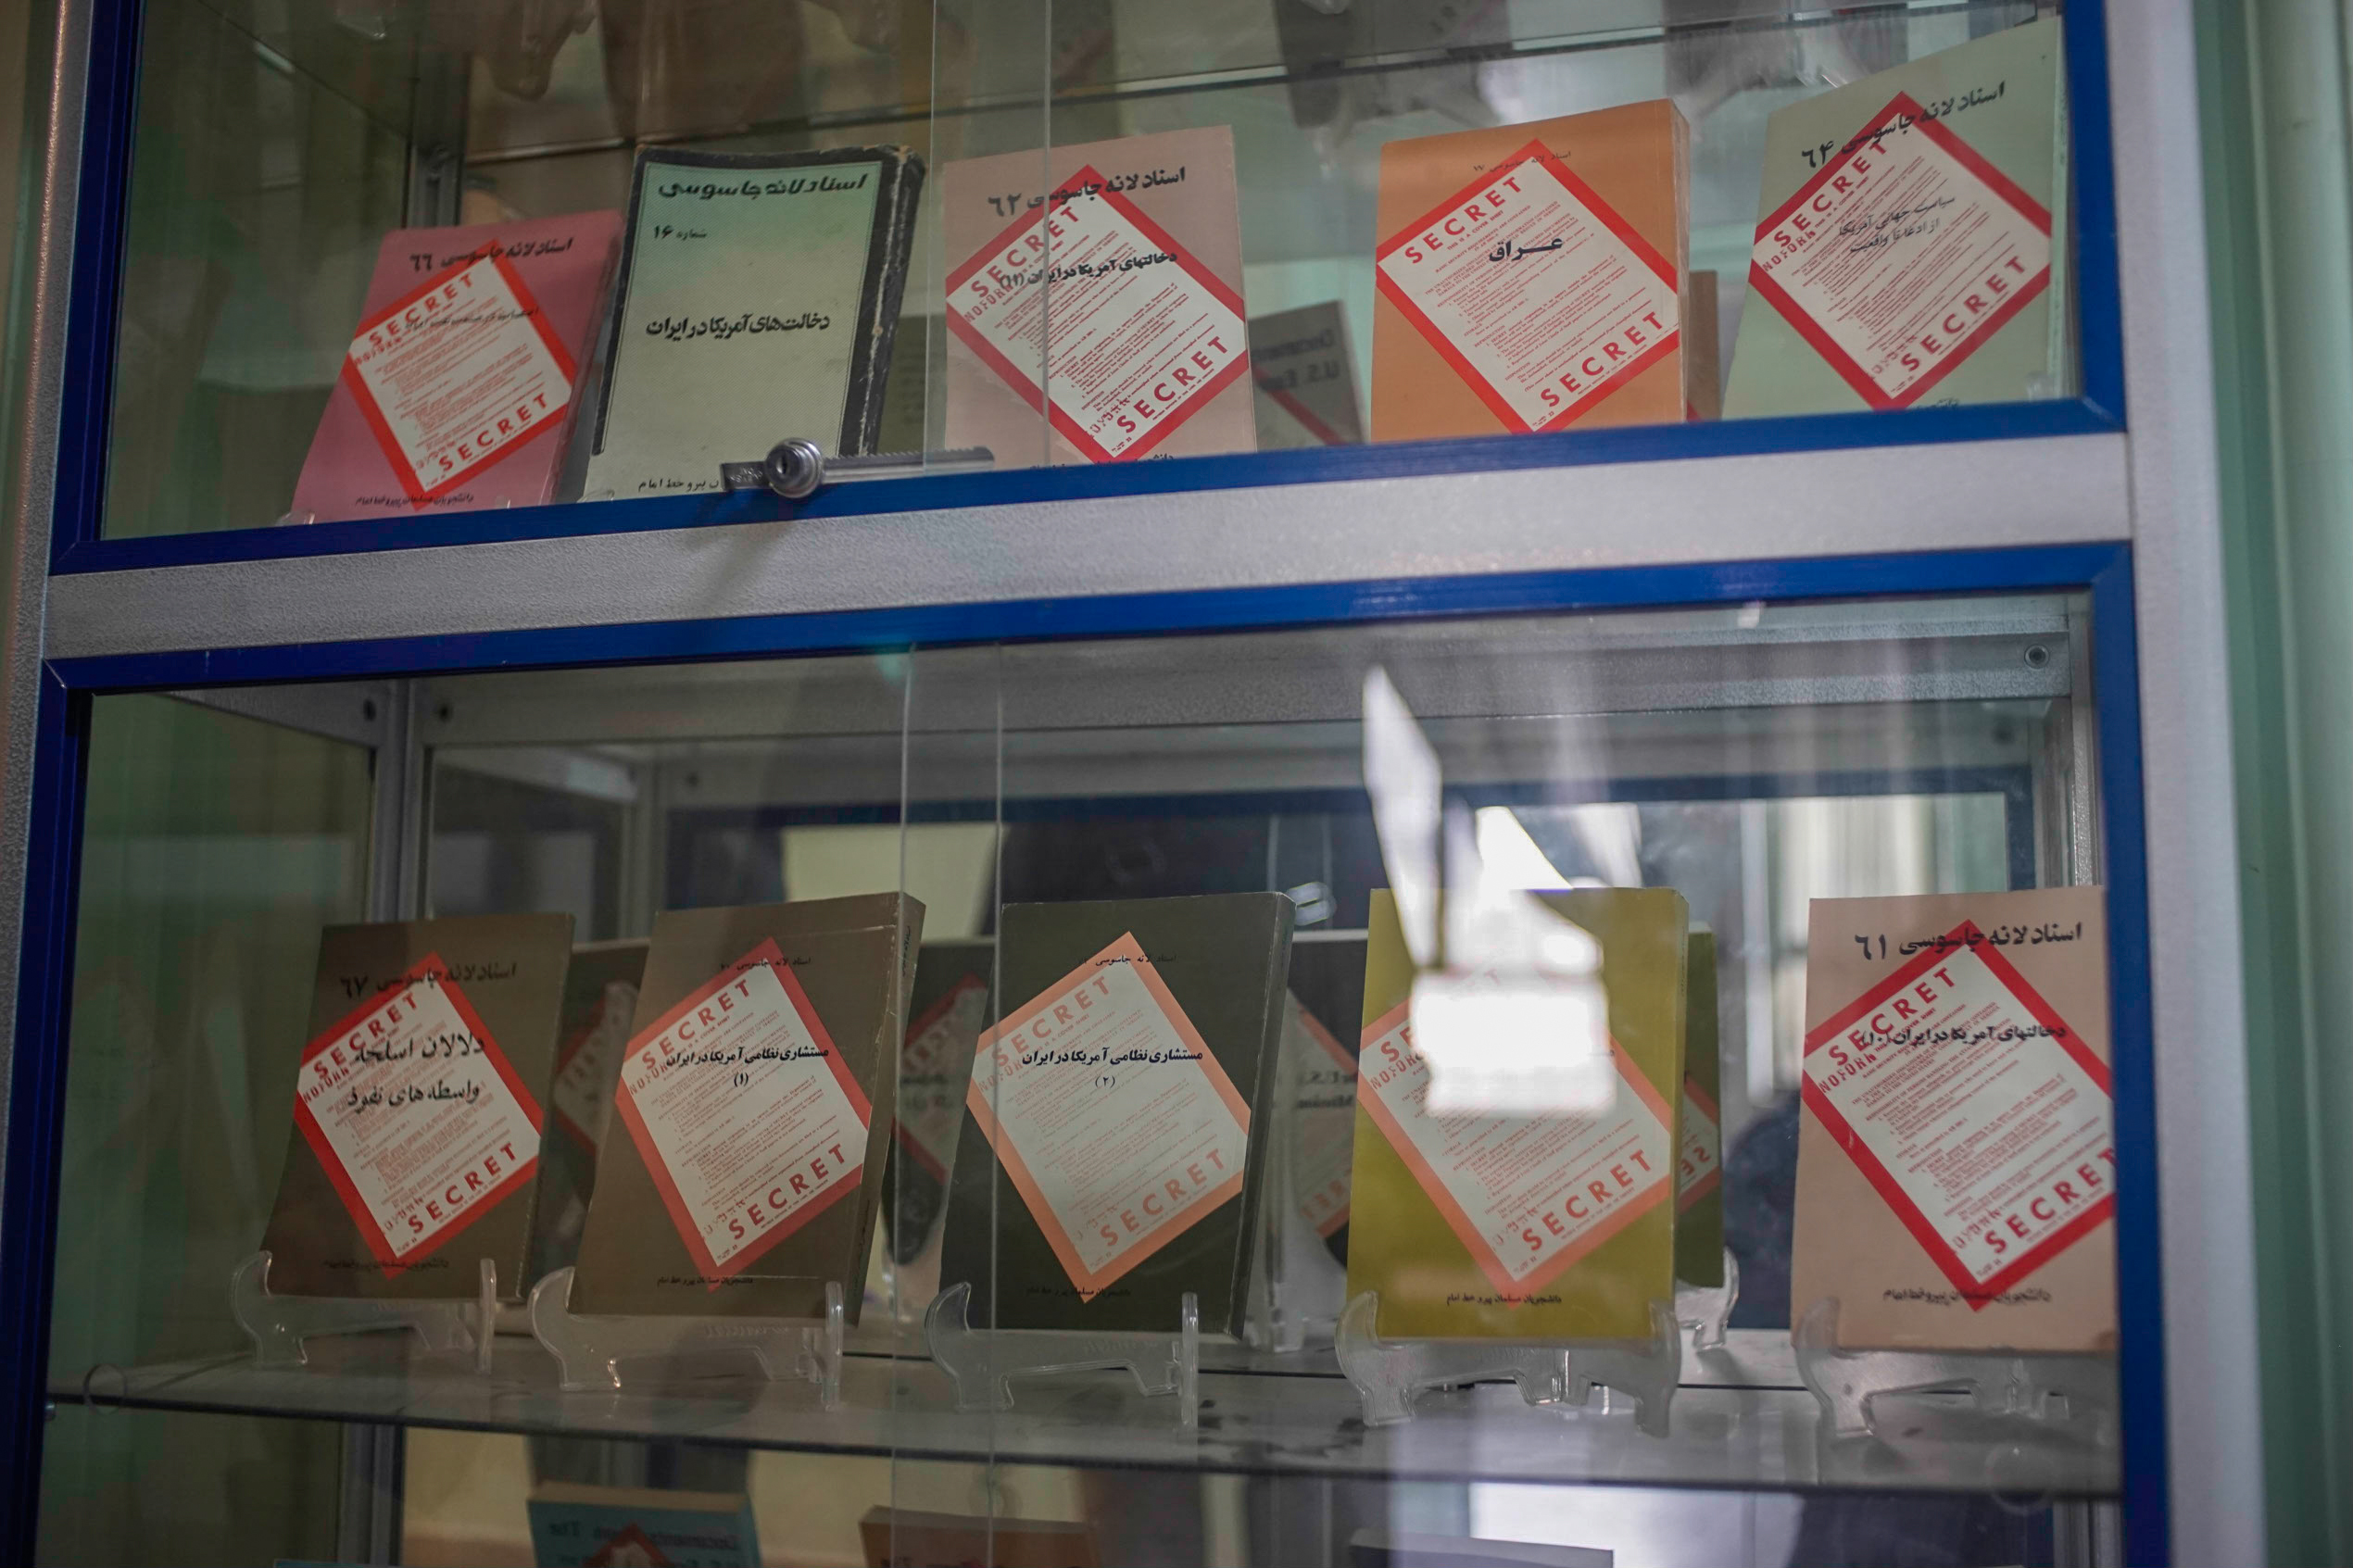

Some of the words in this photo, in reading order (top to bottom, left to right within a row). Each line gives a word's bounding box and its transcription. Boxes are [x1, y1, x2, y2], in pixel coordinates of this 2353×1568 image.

[1957, 81, 2005, 111] اسناد
[1919, 98, 1954, 123] لانه
[1841, 112, 1916, 154] جاسوسی
[766, 179, 807, 195] لانه
[804, 173, 867, 193] اسناد
[1106, 173, 1139, 193] لانه
[1141, 166, 1186, 188] اسناد
[659, 181, 761, 200] جاسوسی
[1026, 180, 1102, 208] جاسوسی
[1772, 144, 1887, 247] SECRET
[1405, 177, 1521, 264] SECRET
[1470, 220, 1489, 233] COVER
[971, 207, 1080, 296] SECRET
[1489, 238, 1563, 261] عراق
[1063, 267, 1078, 280] در
[1078, 259, 1117, 278] آمریکا
[370, 273, 473, 348] SECRET
[1901, 257, 2025, 370] SECRET
[646, 317, 689, 342] ایران
[689, 320, 708, 338] در
[710, 314, 753, 339] آمریکا
[1541, 312, 1664, 407] SECRET
[1117, 337, 1228, 433] SECRET
[439, 393, 548, 471] SECRET
[1899, 928, 1985, 955] جاسوسی
[1990, 924, 2028, 946] لانه
[2031, 922, 2082, 945] اسناد
[641, 980, 750, 1070] SECRET
[996, 976, 1111, 1068] SECRET
[1829, 968, 1957, 1066] SECRET
[314, 993, 419, 1079] SECRET
[422, 1033, 484, 1059] دلالان
[1894, 1028, 1931, 1047] ایران
[1950, 1025, 1994, 1045] آمریکا
[666, 1051, 695, 1068] ایران
[695, 1052, 708, 1065] در
[710, 1047, 743, 1065] آمریکا
[744, 1047, 779, 1063] نظامی
[779, 1046, 829, 1061] مستشاری
[1022, 1050, 1054, 1066] ایران
[1054, 1054, 1069, 1065] در
[1071, 1047, 1111, 1065] آمریکا
[1110, 1048, 1148, 1065] نظامی
[1149, 1047, 1203, 1063] مستشاری
[1370, 1054, 1416, 1092] NOFOR
[409, 1143, 518, 1233] SECRET
[729, 1145, 846, 1239] SECRET
[1099, 1148, 1225, 1248] SECRET
[1522, 1150, 1652, 1251] SECRET
[1984, 1148, 2114, 1252] SECRET
